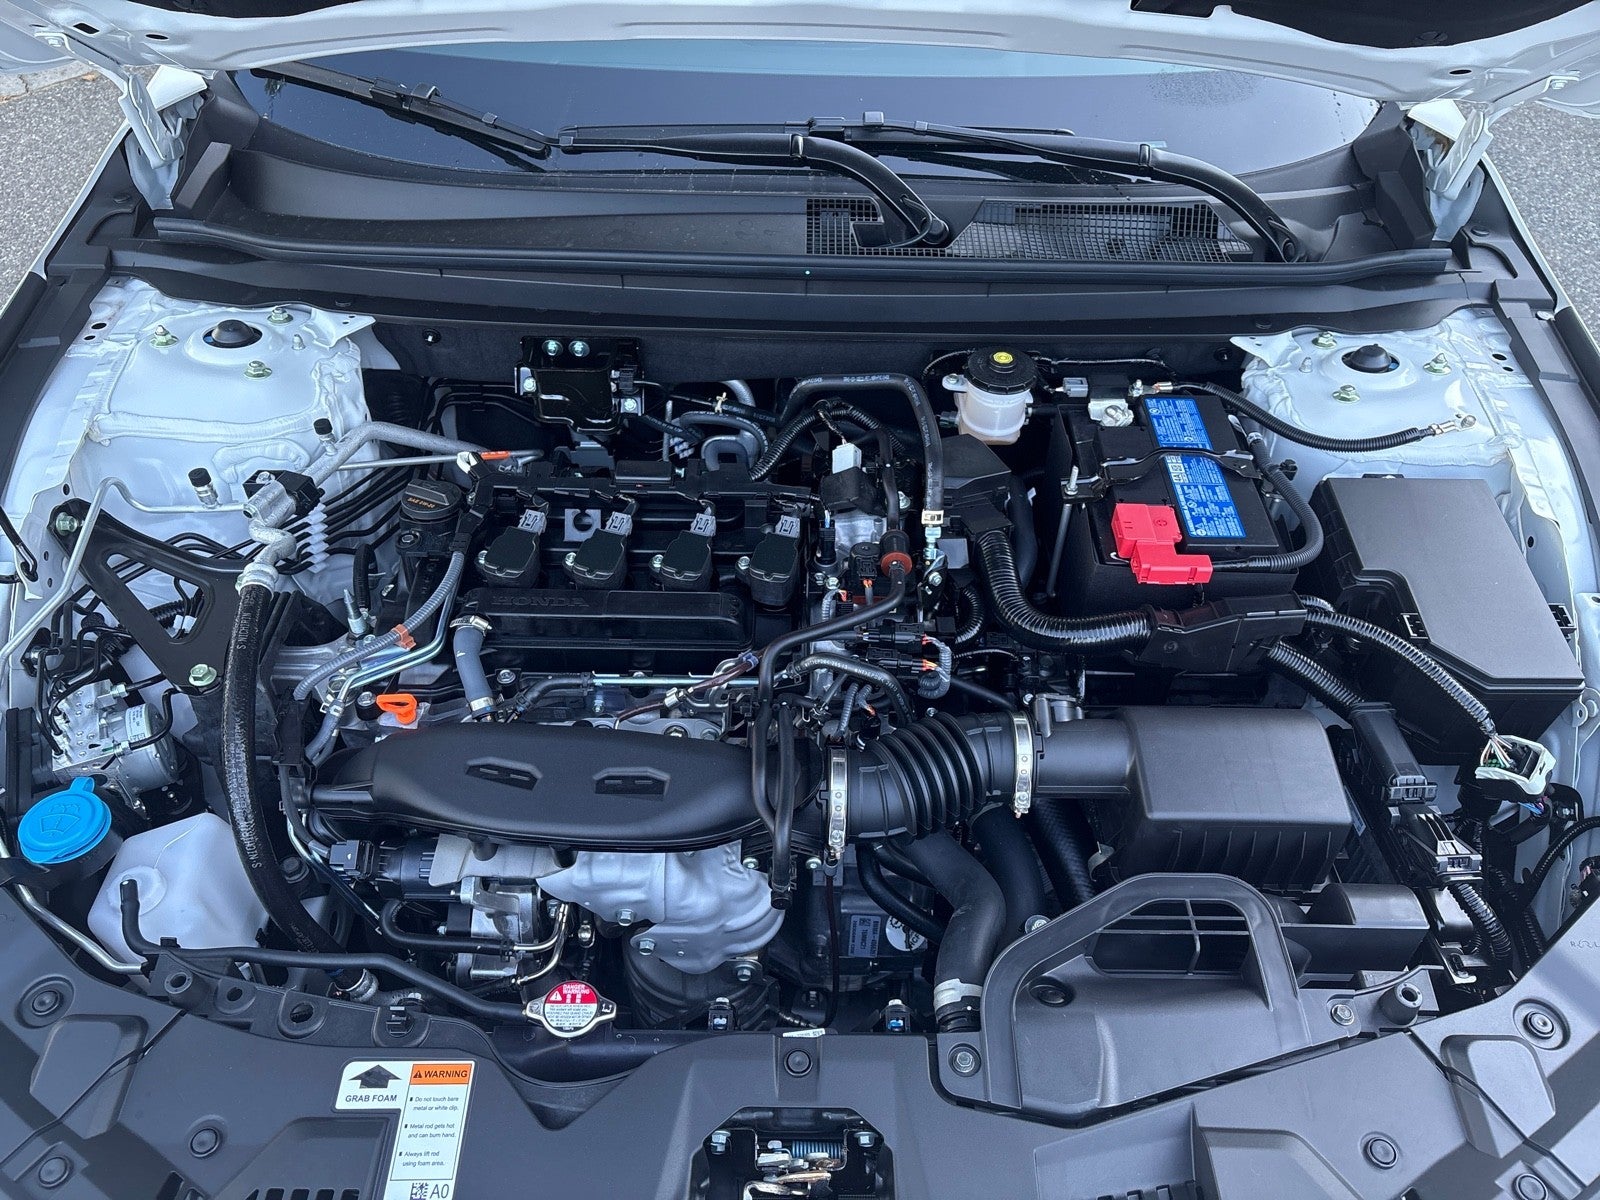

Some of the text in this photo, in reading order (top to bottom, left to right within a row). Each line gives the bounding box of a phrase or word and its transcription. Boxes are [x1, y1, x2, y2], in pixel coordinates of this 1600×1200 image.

[491, 596, 590, 607] HONDA
[424, 1070, 468, 1078] WARNING
[372, 1094, 398, 1102] FOAM
